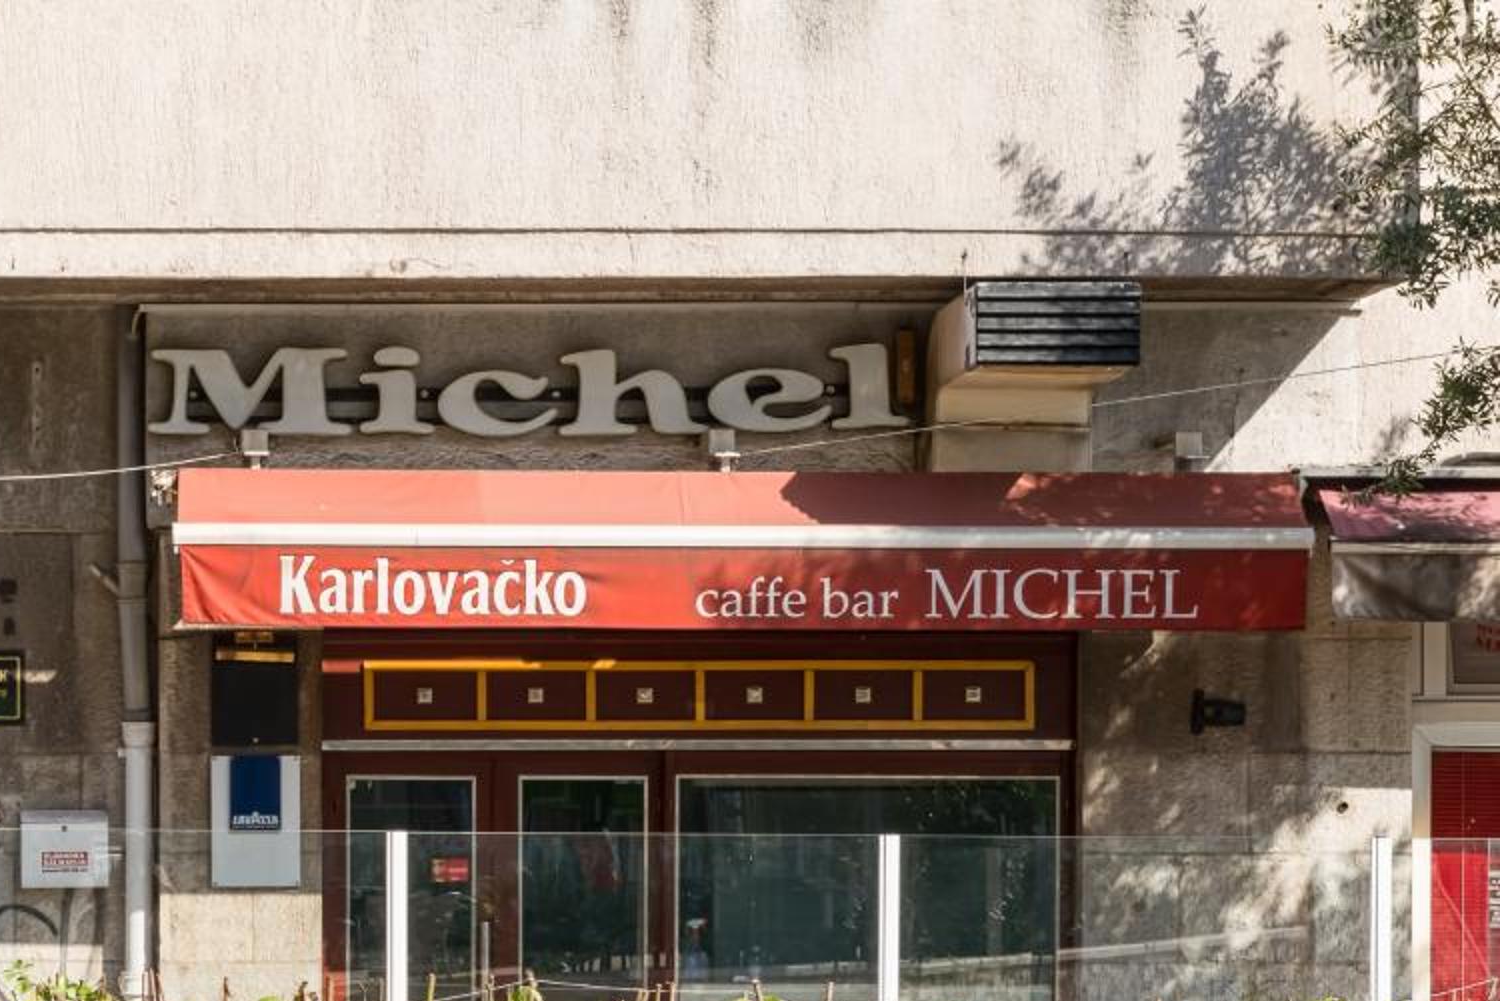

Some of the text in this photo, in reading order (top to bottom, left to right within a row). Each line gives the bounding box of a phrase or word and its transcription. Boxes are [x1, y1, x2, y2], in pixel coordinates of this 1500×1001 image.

[148, 343, 909, 436] Michel
[279, 555, 587, 616] Karlovačko
[695, 568, 1198, 619] caffe bar MICHEL
